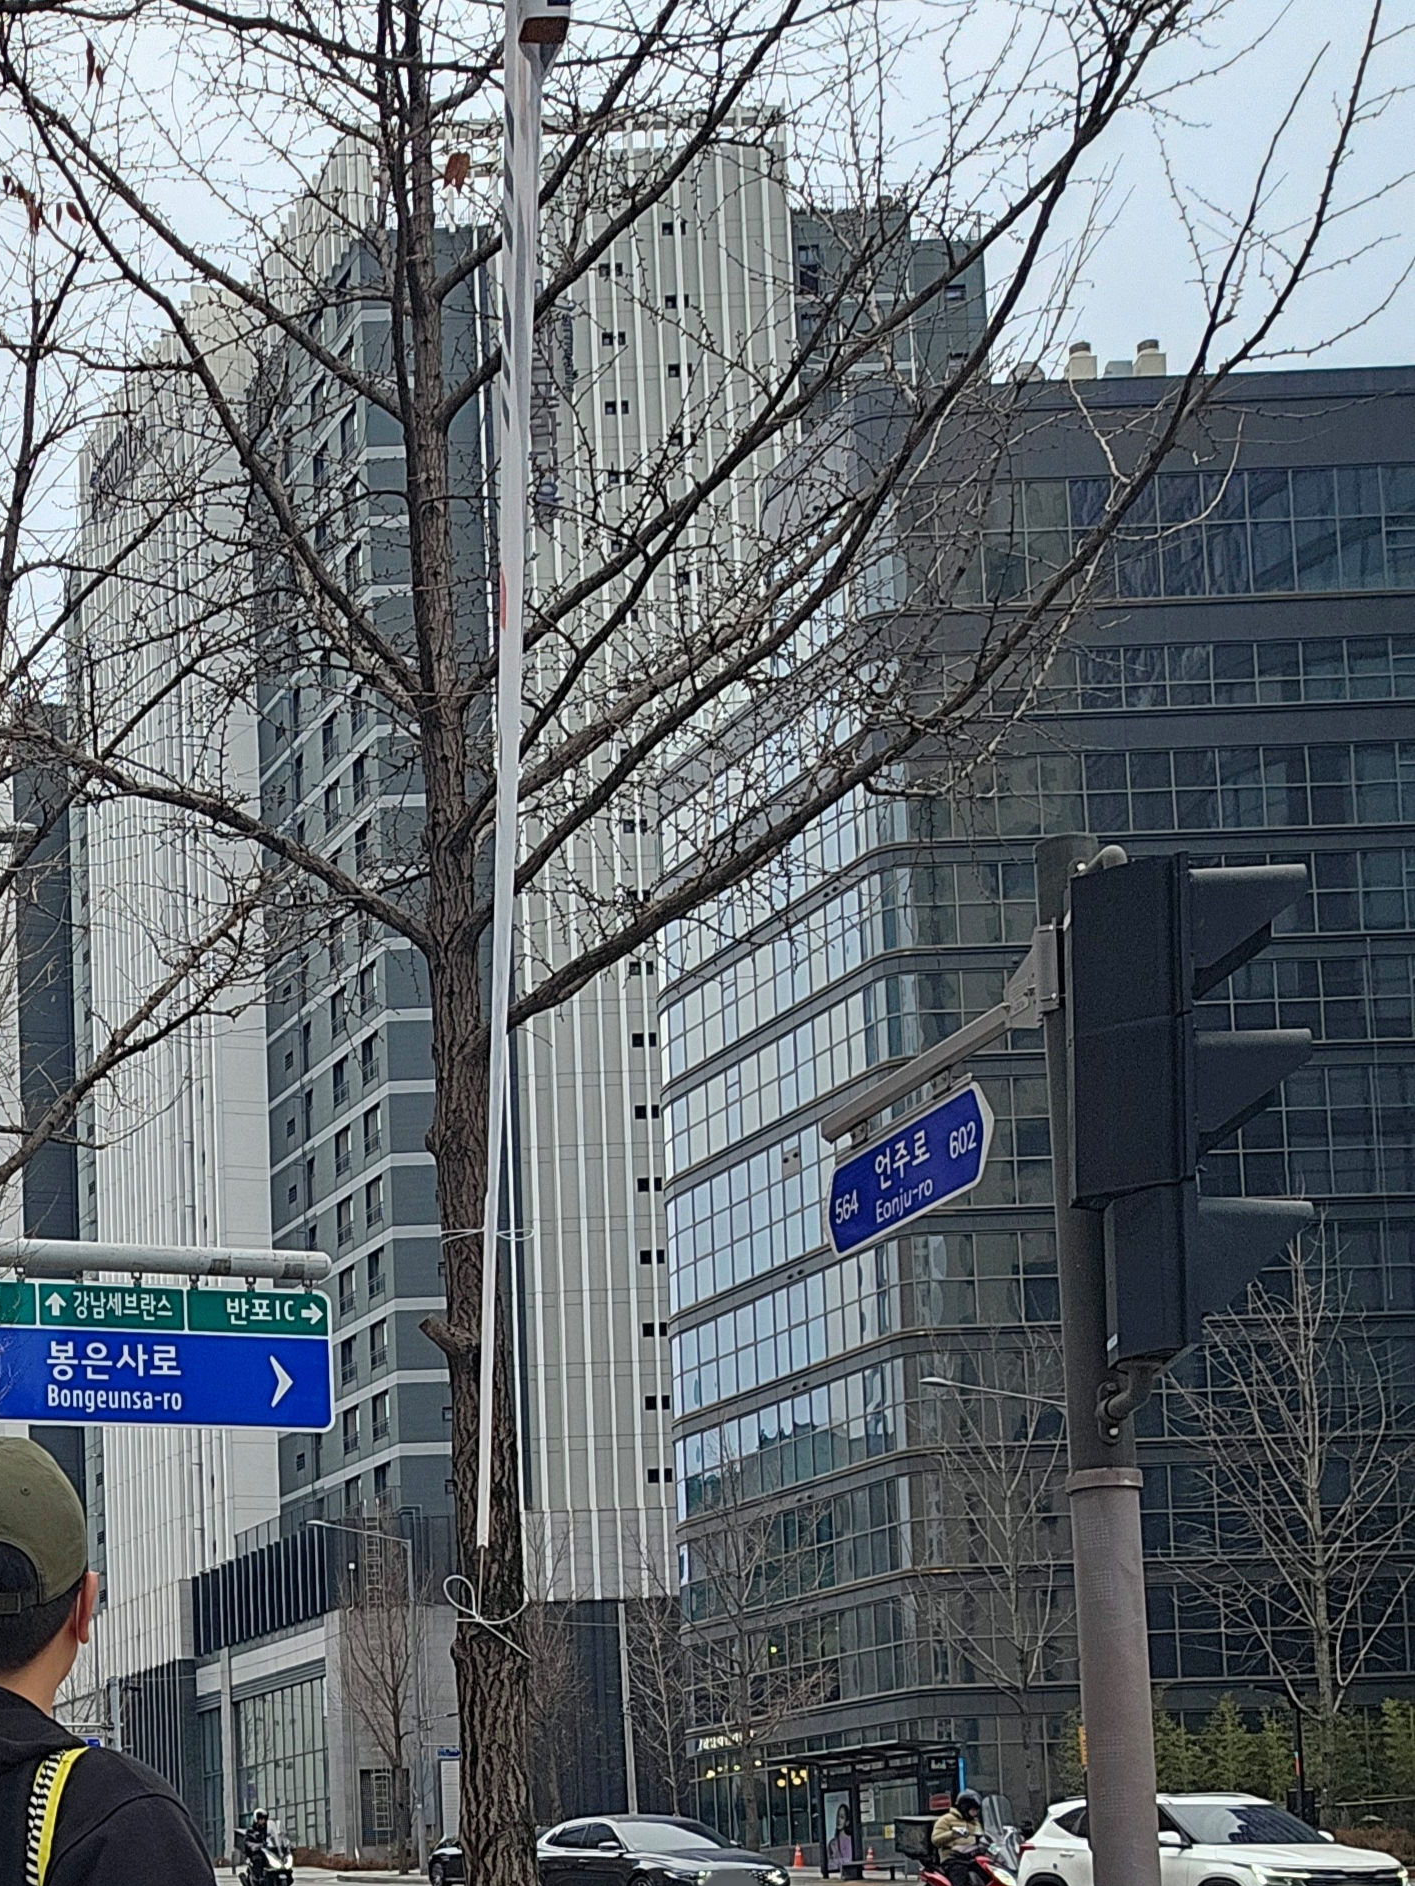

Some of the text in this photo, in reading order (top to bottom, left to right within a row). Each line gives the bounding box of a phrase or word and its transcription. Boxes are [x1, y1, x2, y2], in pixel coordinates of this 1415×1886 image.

[949, 1121, 977, 1159] 602
[874, 1129, 930, 1190] 언주로
[835, 1188, 859, 1224] 564
[875, 1178, 933, 1224] Eonju-ro
[72, 1289, 173, 1321] 강남세브란스
[225, 1297, 297, 1325] 반포IC
[46, 1340, 182, 1382] 봉은사로
[46, 1384, 183, 1413] Bongeunsa-ro
